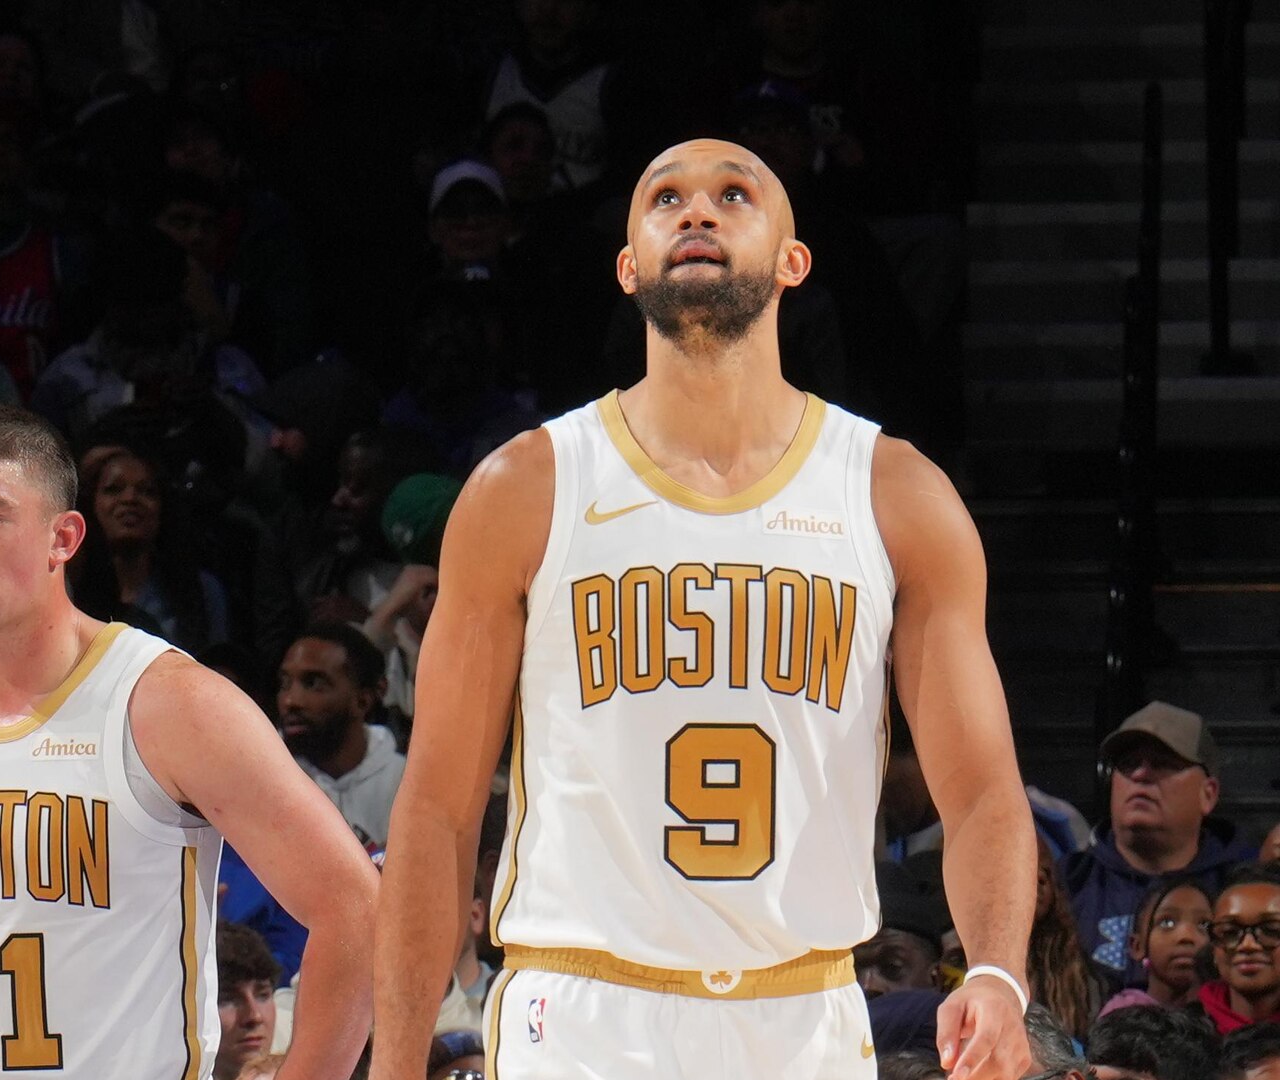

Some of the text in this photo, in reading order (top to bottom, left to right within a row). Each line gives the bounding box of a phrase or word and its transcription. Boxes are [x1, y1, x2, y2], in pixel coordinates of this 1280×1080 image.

[766, 509, 844, 536] Amica
[571, 563, 857, 714] BOSTON
[32, 736, 97, 758] Amica
[664, 722, 777, 881] 9
